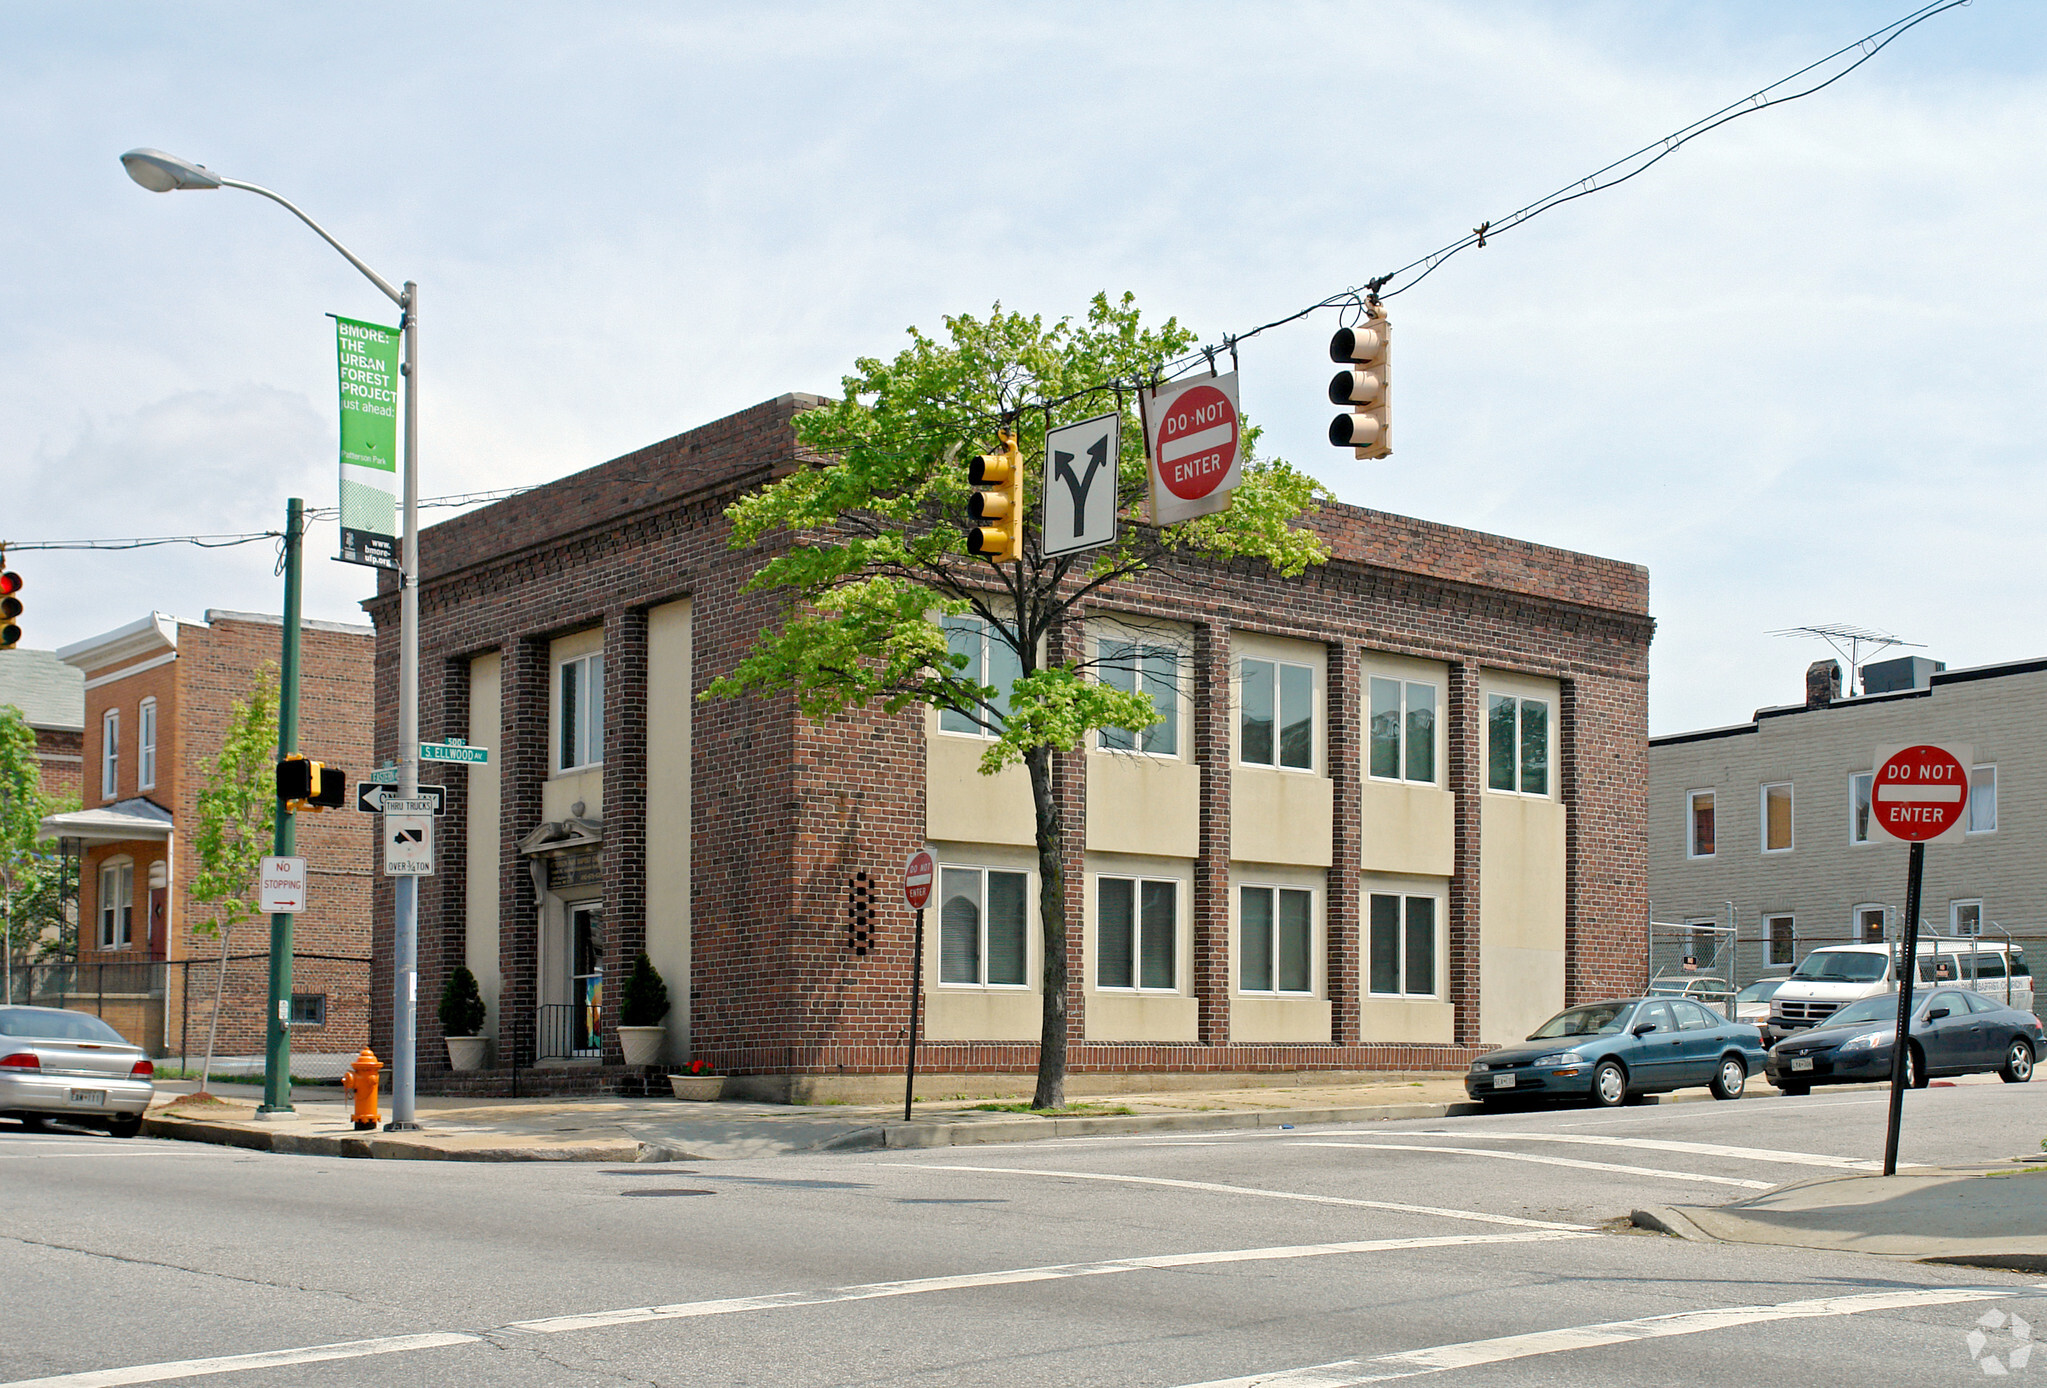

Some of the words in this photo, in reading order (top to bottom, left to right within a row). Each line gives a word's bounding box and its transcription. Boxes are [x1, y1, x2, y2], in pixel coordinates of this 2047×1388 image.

[340, 323, 389, 344] BMORE:
[339, 337, 365, 353] THE
[340, 352, 385, 372] URBAN
[341, 367, 390, 387] FOREST
[341, 382, 397, 403] PROJECT
[1168, 414, 1187, 435] DO
[1196, 401, 1224, 425] NOT
[373, 455, 386, 464] Park
[1175, 454, 1220, 482] ENTER
[435, 748, 473, 760] ELLWOOD
[373, 771, 394, 783] EASTERN
[1888, 765, 1910, 779] DO
[1919, 765, 1955, 779] NOT
[387, 802, 403, 810] THRU
[406, 802, 431, 810] TRUCKS
[1890, 808, 1944, 823] ENTER
[276, 863, 290, 872] NO
[388, 862, 405, 871] OVER
[416, 862, 429, 871] TON
[264, 880, 301, 889] STOPPING
[910, 888, 927, 897] ENTER
[1978, 982, 1999, 992] BAPTIST
[2001, 980, 2023, 990] CHRCH
